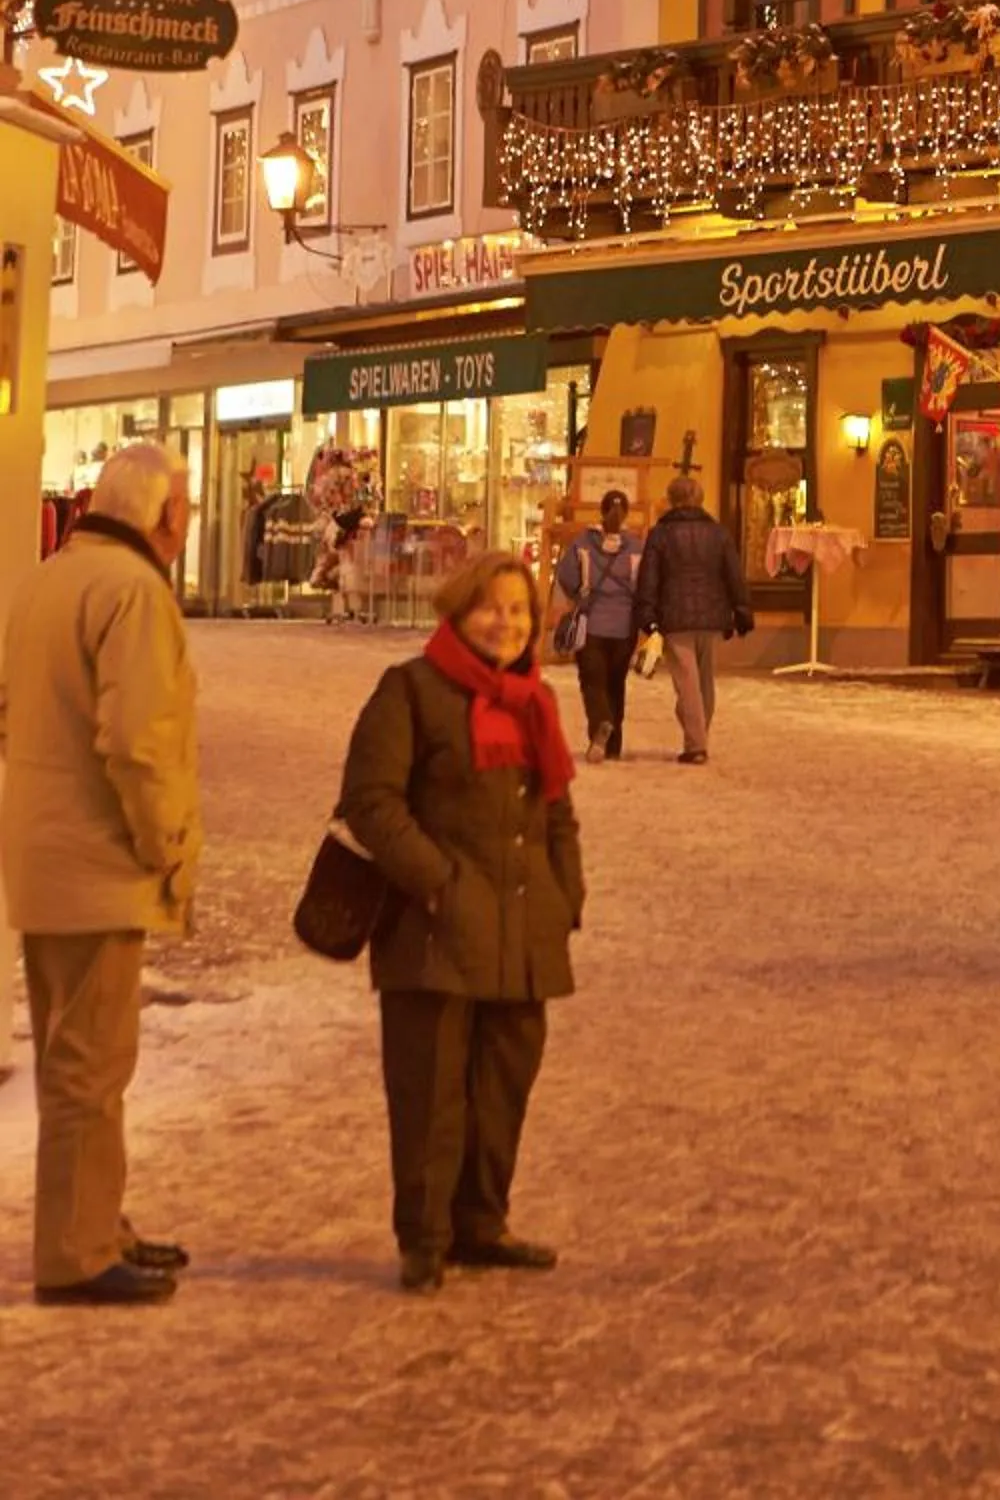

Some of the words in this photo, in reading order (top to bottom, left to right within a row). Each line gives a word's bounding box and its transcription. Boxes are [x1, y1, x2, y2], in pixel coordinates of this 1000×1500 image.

[45, 1, 219, 44] Feinschmeck
[719, 243, 949, 315] Sportstüberl
[349, 358, 440, 400] SPIELWAREN
[455, 353, 495, 389] TOYS
